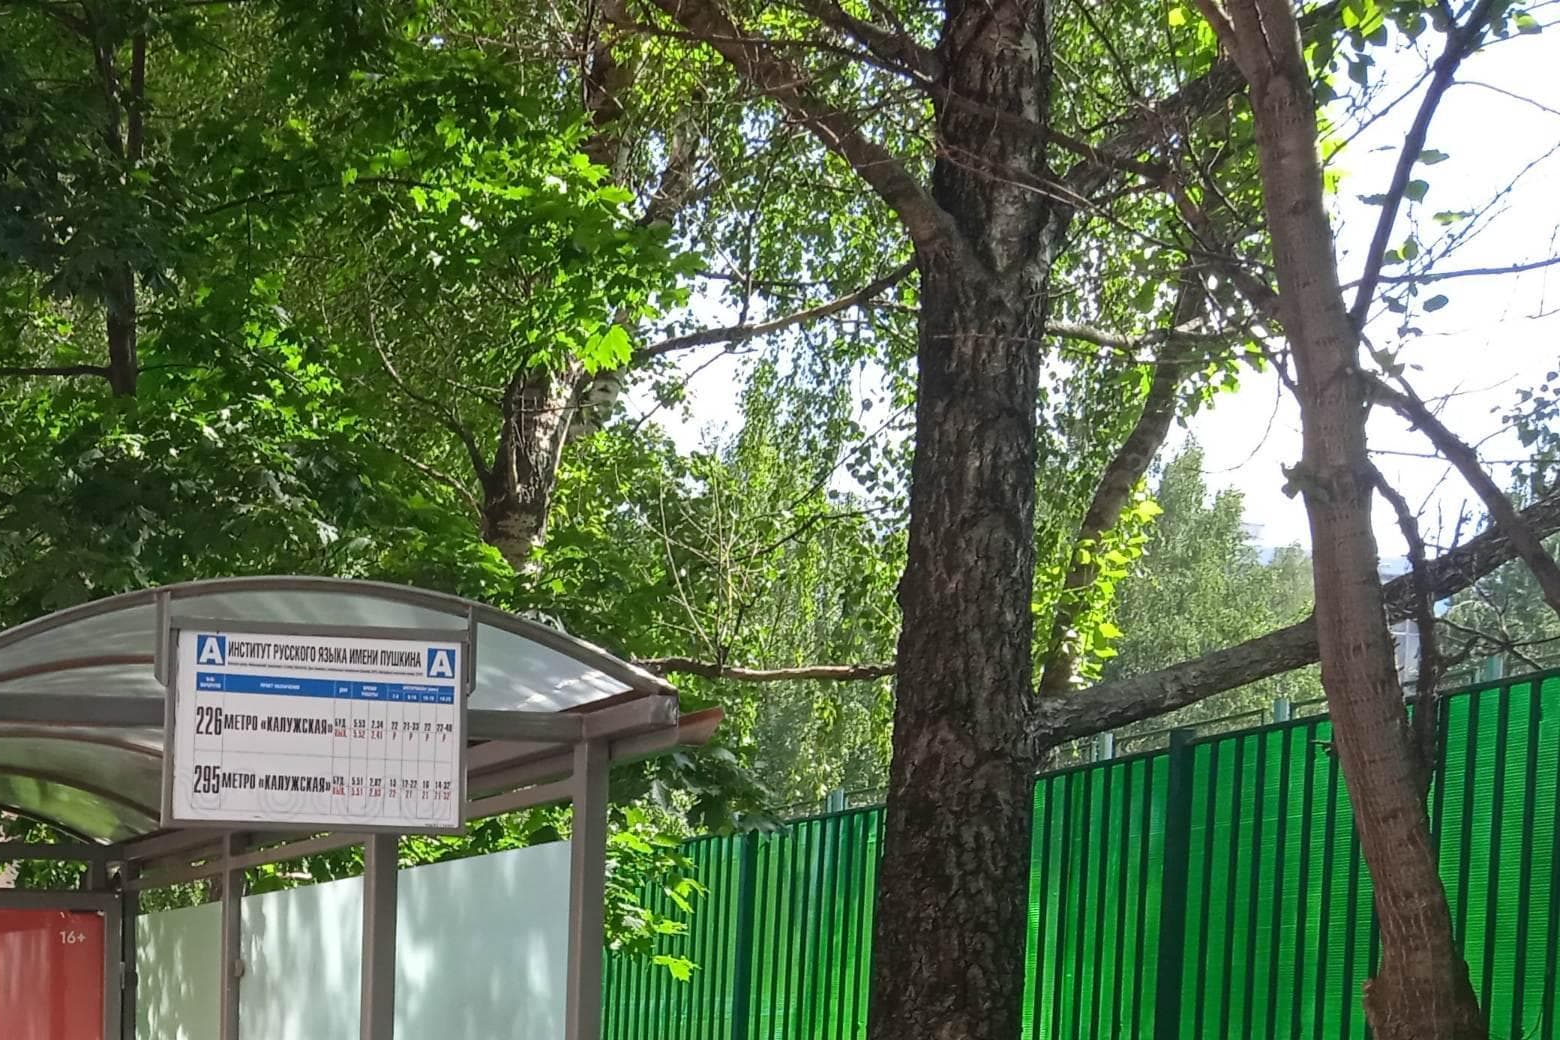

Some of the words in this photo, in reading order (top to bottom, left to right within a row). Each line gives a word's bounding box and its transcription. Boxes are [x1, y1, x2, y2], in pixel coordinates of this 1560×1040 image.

[228, 641, 271, 659] ИНСТИТУТ
[274, 644, 316, 662] РУССКОГО
[318, 646, 347, 664] ЯЗЫКА
[349, 648, 378, 665] ИМЕНИ
[380, 650, 421, 668] ПУШКИНА
[196, 706, 222, 735] 226
[224, 714, 258, 731] МЕТРО
[261, 716, 333, 735] «КАЛУЖСКАЯ»
[193, 765, 220, 794] 295
[222, 772, 256, 789] МЕТРО
[258, 774, 331, 792] «КАЛУЖСКАЯ»
[59, 931, 86, 945] 16+
